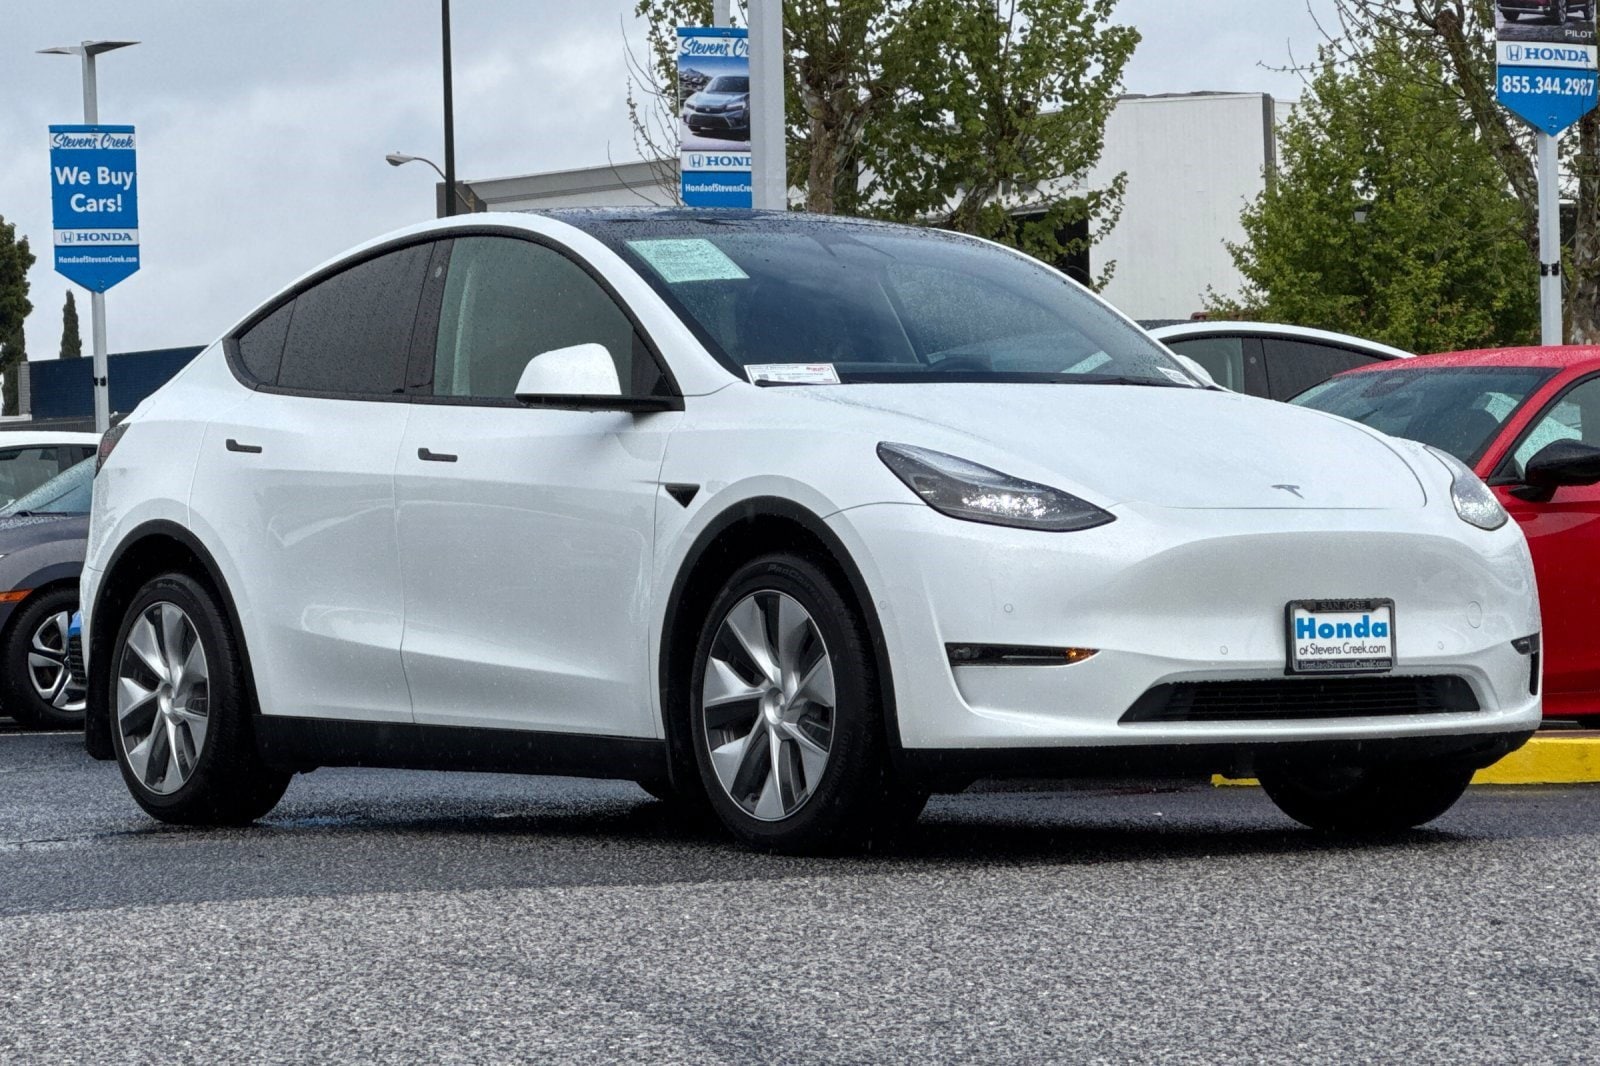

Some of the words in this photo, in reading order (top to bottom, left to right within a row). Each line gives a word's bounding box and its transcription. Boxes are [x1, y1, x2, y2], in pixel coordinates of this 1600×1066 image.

[1564, 29, 1593, 38] PILOT
[680, 36, 730, 56] Stevens
[1524, 47, 1591, 62] HONDA
[1501, 75, 1595, 97] 855.344.2987
[52, 133, 97, 149] Stevens
[100, 133, 133, 149] Creek
[54, 166, 91, 185] We
[97, 166, 134, 191] Buy
[70, 193, 122, 213] Cars!
[76, 233, 133, 241] HONDA
[1321, 602, 1338, 610] SAN
[1342, 601, 1367, 610] JOSE
[1296, 615, 1388, 639] Honda
[1299, 645, 1309, 655] of
[1310, 643, 1342, 655] Stevens
[1343, 641, 1387, 655] Creek.com
